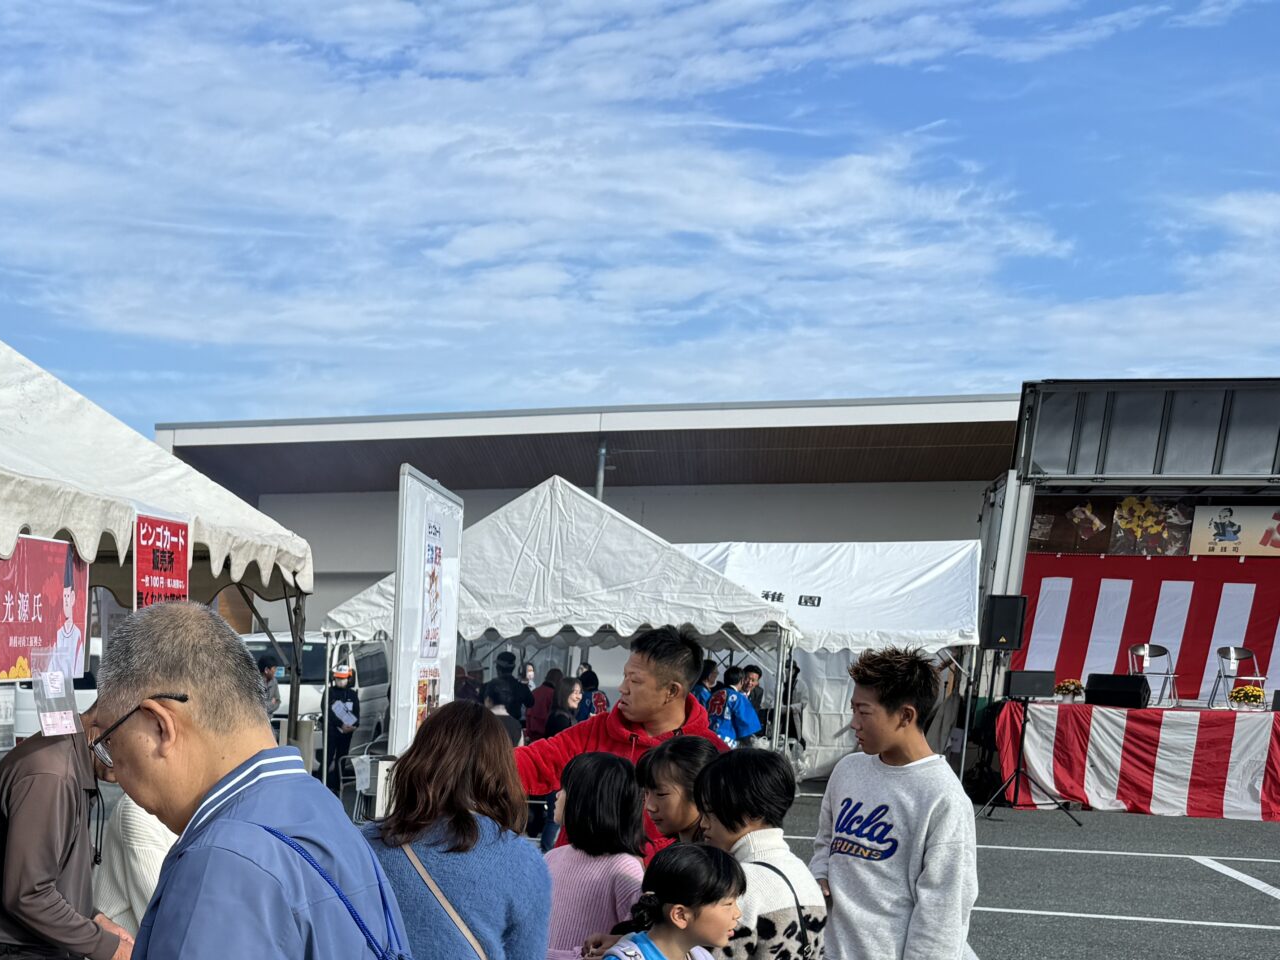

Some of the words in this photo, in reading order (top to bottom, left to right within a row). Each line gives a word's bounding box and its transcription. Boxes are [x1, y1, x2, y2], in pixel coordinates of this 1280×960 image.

[140, 522, 185, 551] ビンゴカード
[1, 590, 43, 624] 光源氏
